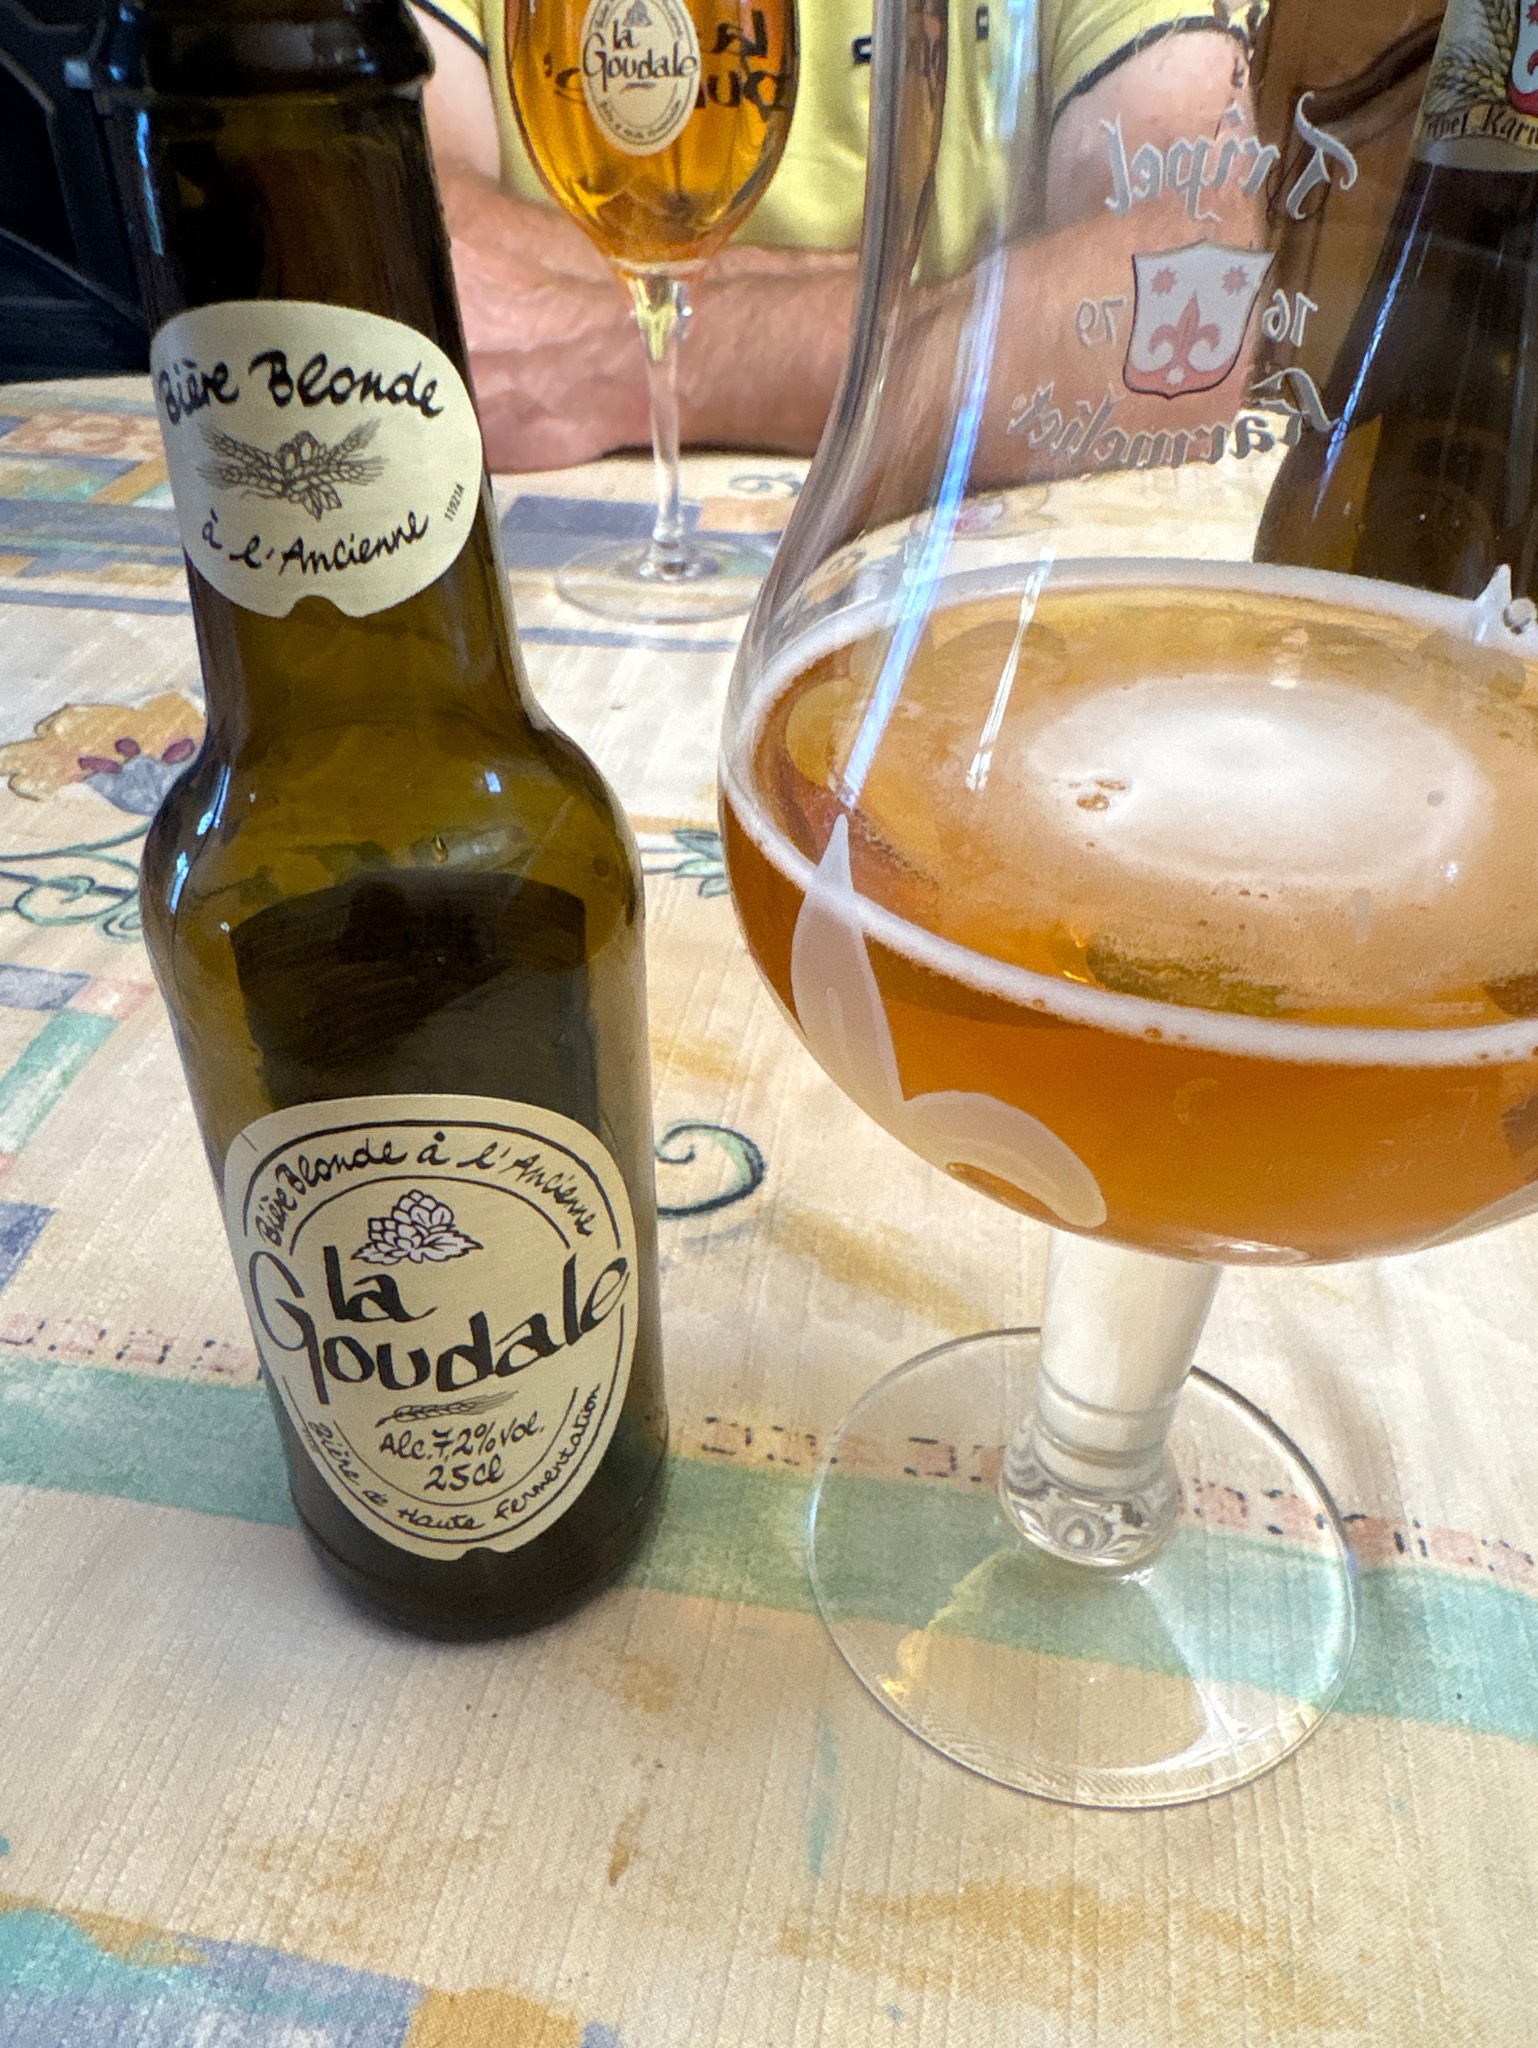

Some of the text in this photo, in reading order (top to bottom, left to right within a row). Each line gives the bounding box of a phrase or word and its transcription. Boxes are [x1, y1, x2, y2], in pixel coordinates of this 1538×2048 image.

[582, 32, 698, 93] Goudale
[158, 348, 444, 426] Bière Blonde
[202, 508, 223, 550] à
[275, 1137, 409, 1196] Blonde
[416, 1131, 451, 1166] à
[255, 1187, 298, 1248] Bière
[249, 1250, 630, 1406] Goudale
[308, 1421, 361, 1487] Bière
[397, 1506, 486, 1531] Haute
[493, 1382, 601, 1520] Fermentation
